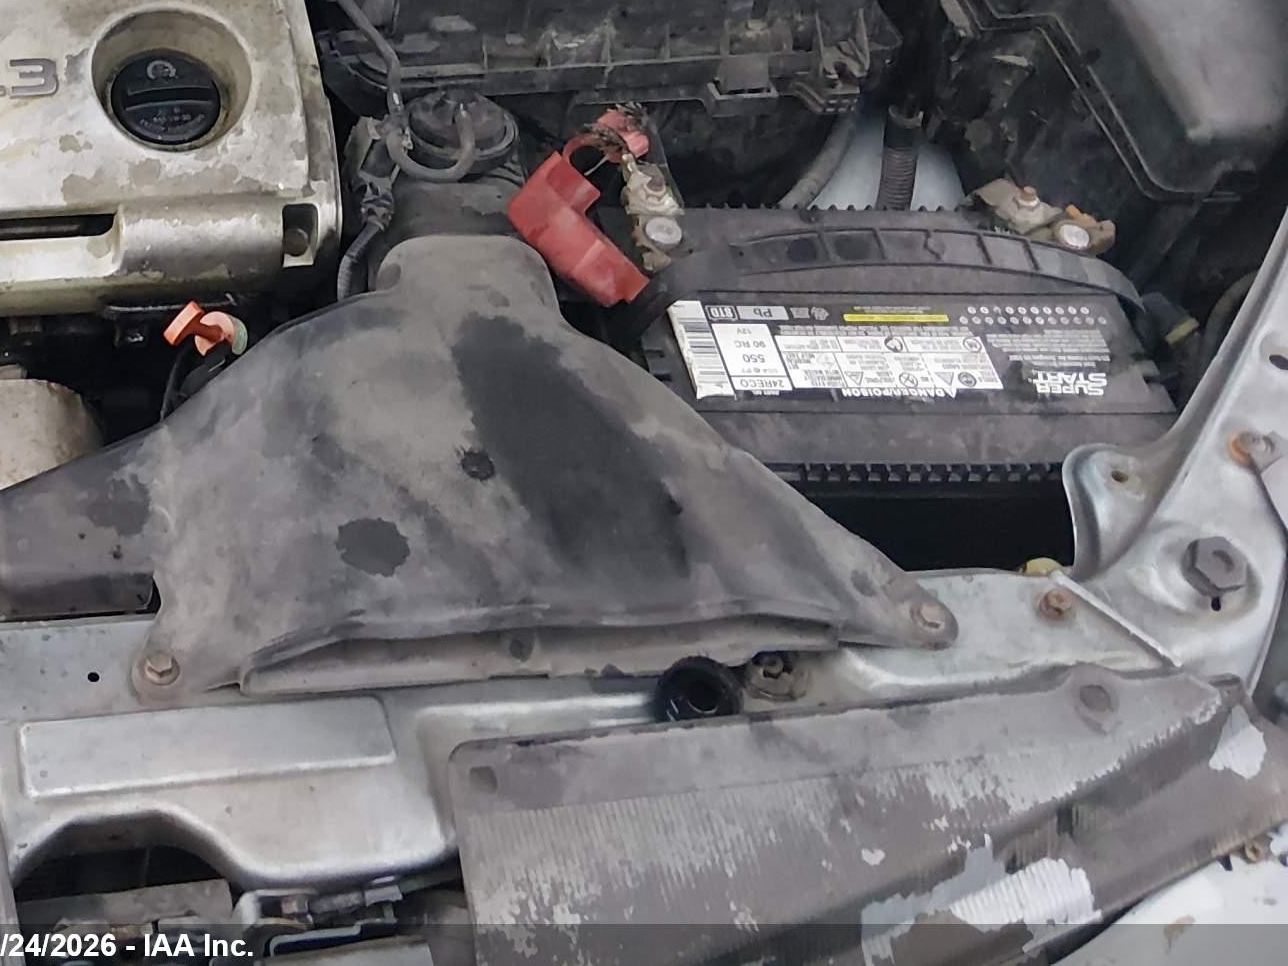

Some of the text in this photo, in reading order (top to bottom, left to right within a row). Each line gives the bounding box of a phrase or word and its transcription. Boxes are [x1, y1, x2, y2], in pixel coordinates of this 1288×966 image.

[753, 308, 773, 318] Pb
[742, 353, 765, 363] 550
[1032, 371, 1107, 387] START
[1035, 383, 1104, 396] SUPER
